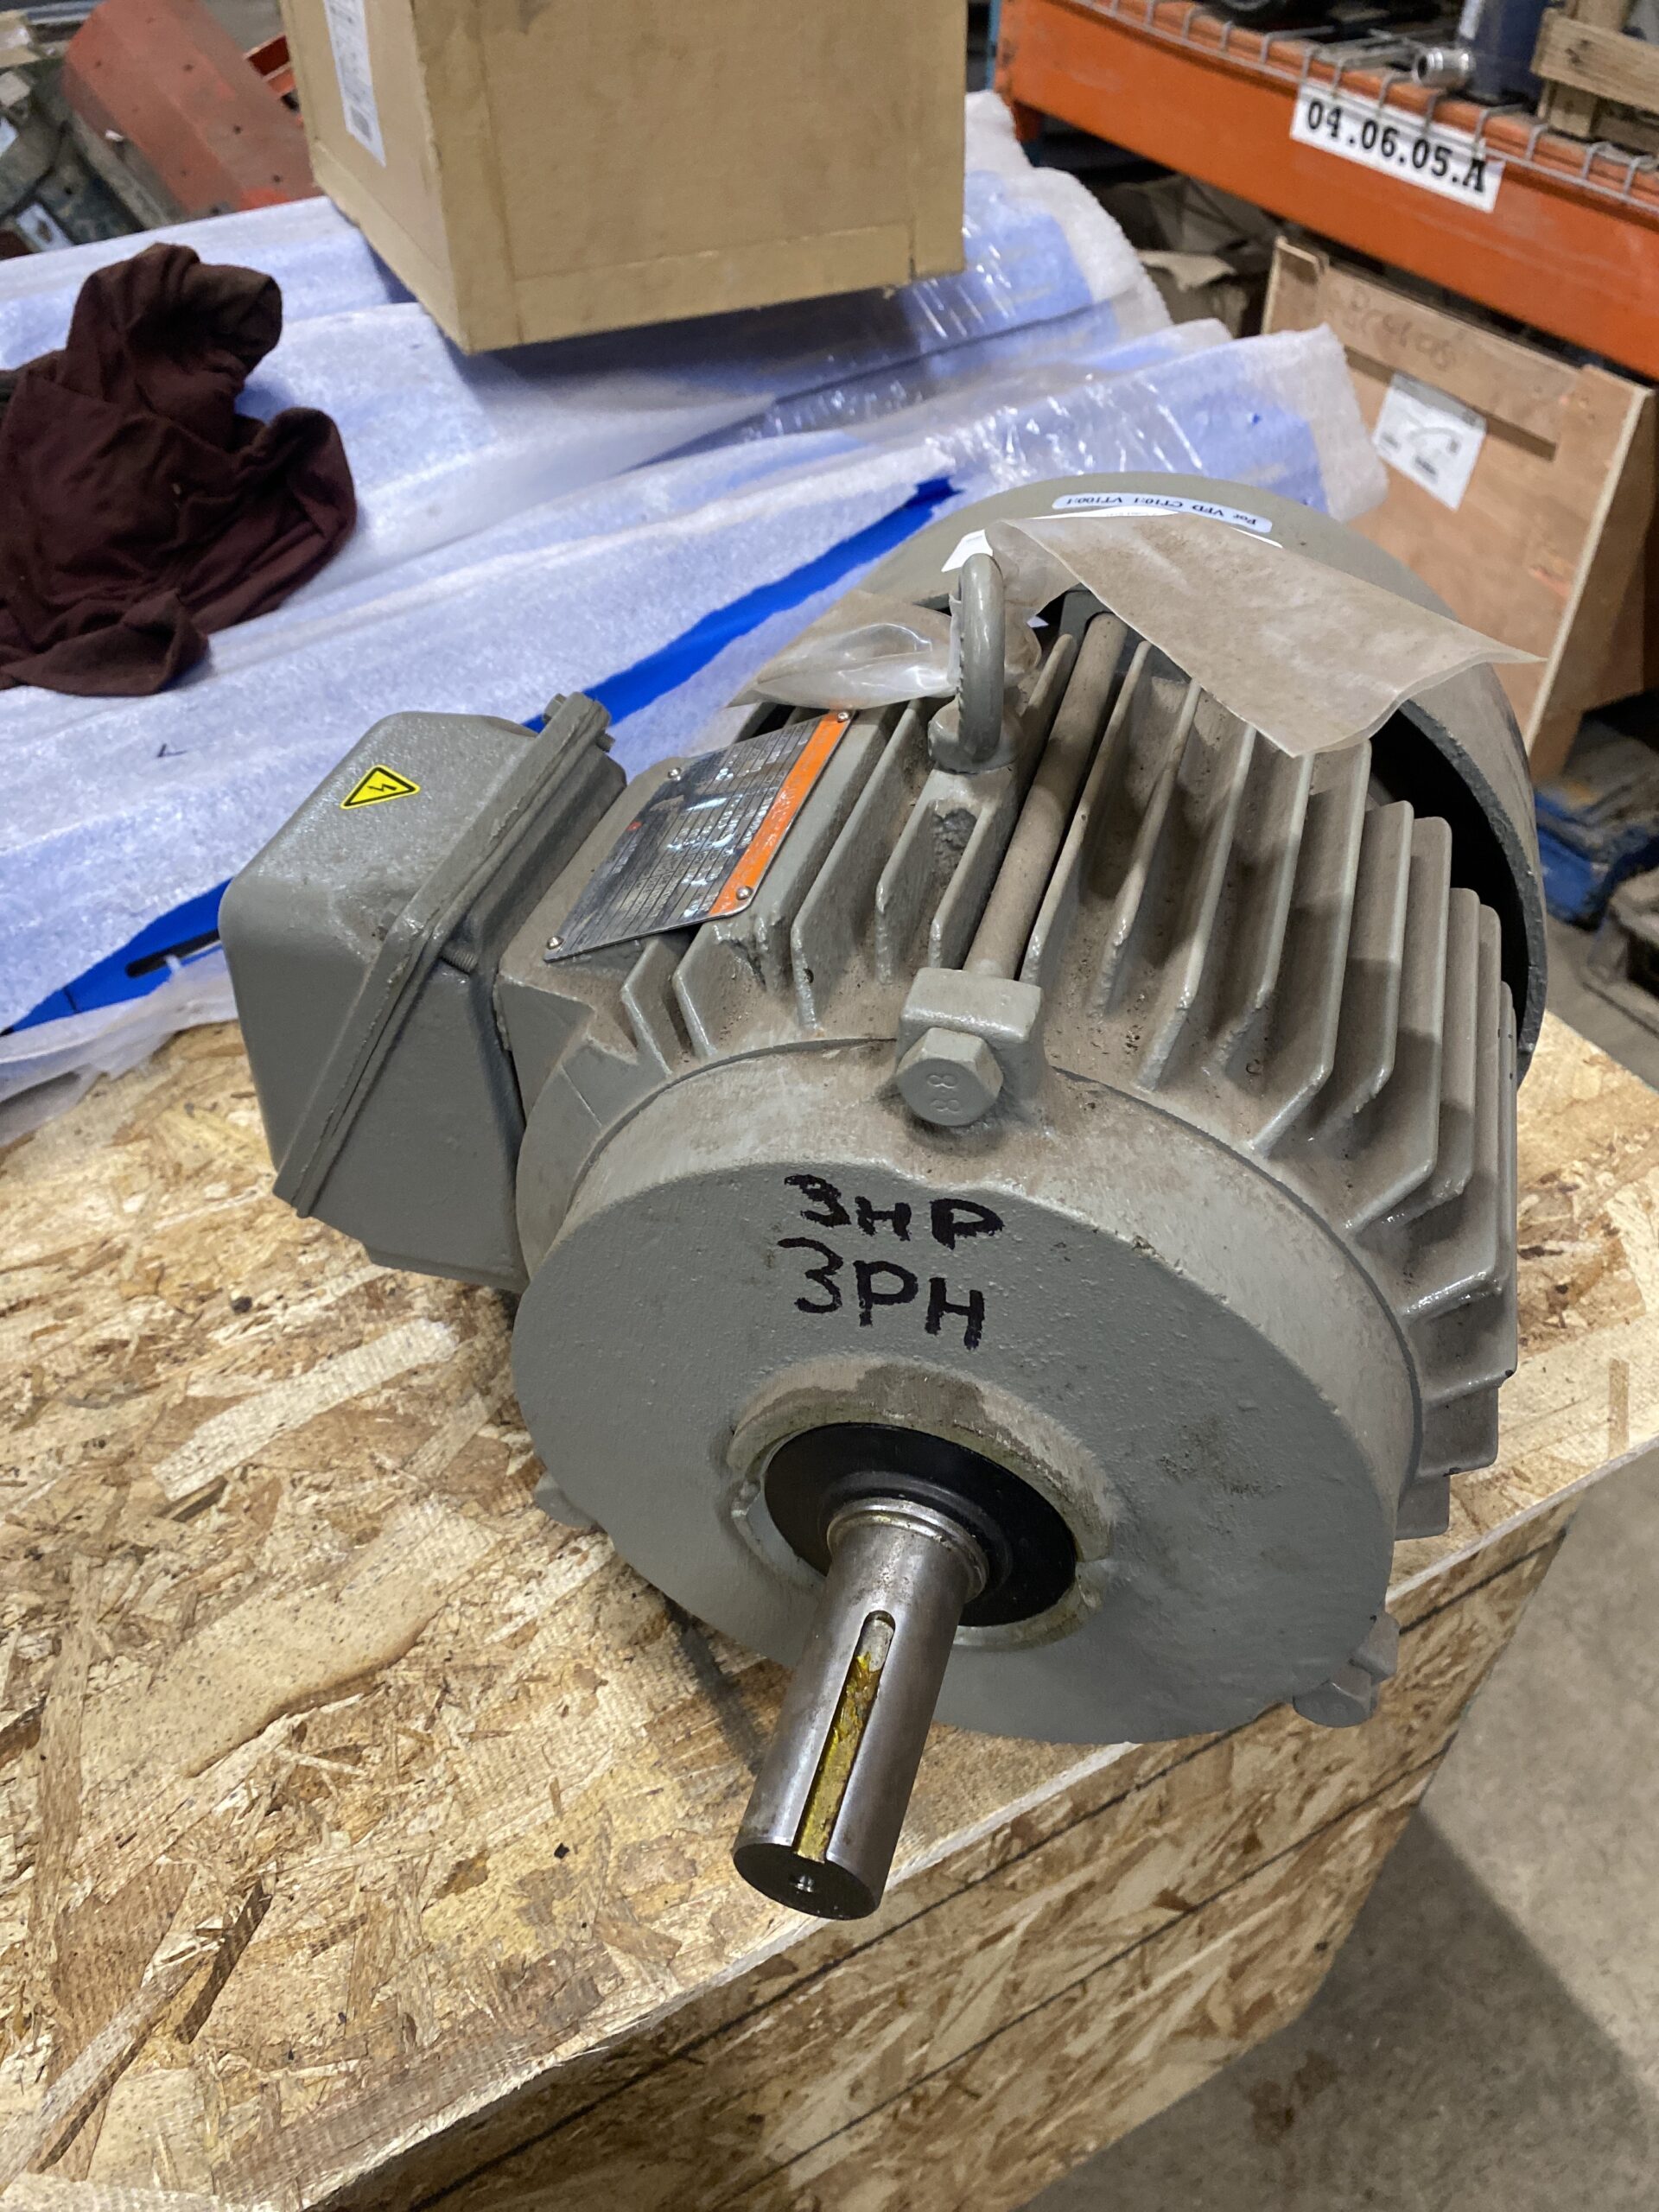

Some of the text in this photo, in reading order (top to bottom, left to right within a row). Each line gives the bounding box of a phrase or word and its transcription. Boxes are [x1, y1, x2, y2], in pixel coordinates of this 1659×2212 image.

[1307, 101, 1486, 192] 04.06.05.A
[1192, 504, 1224, 517] VFD
[1233, 514, 1257, 525] For
